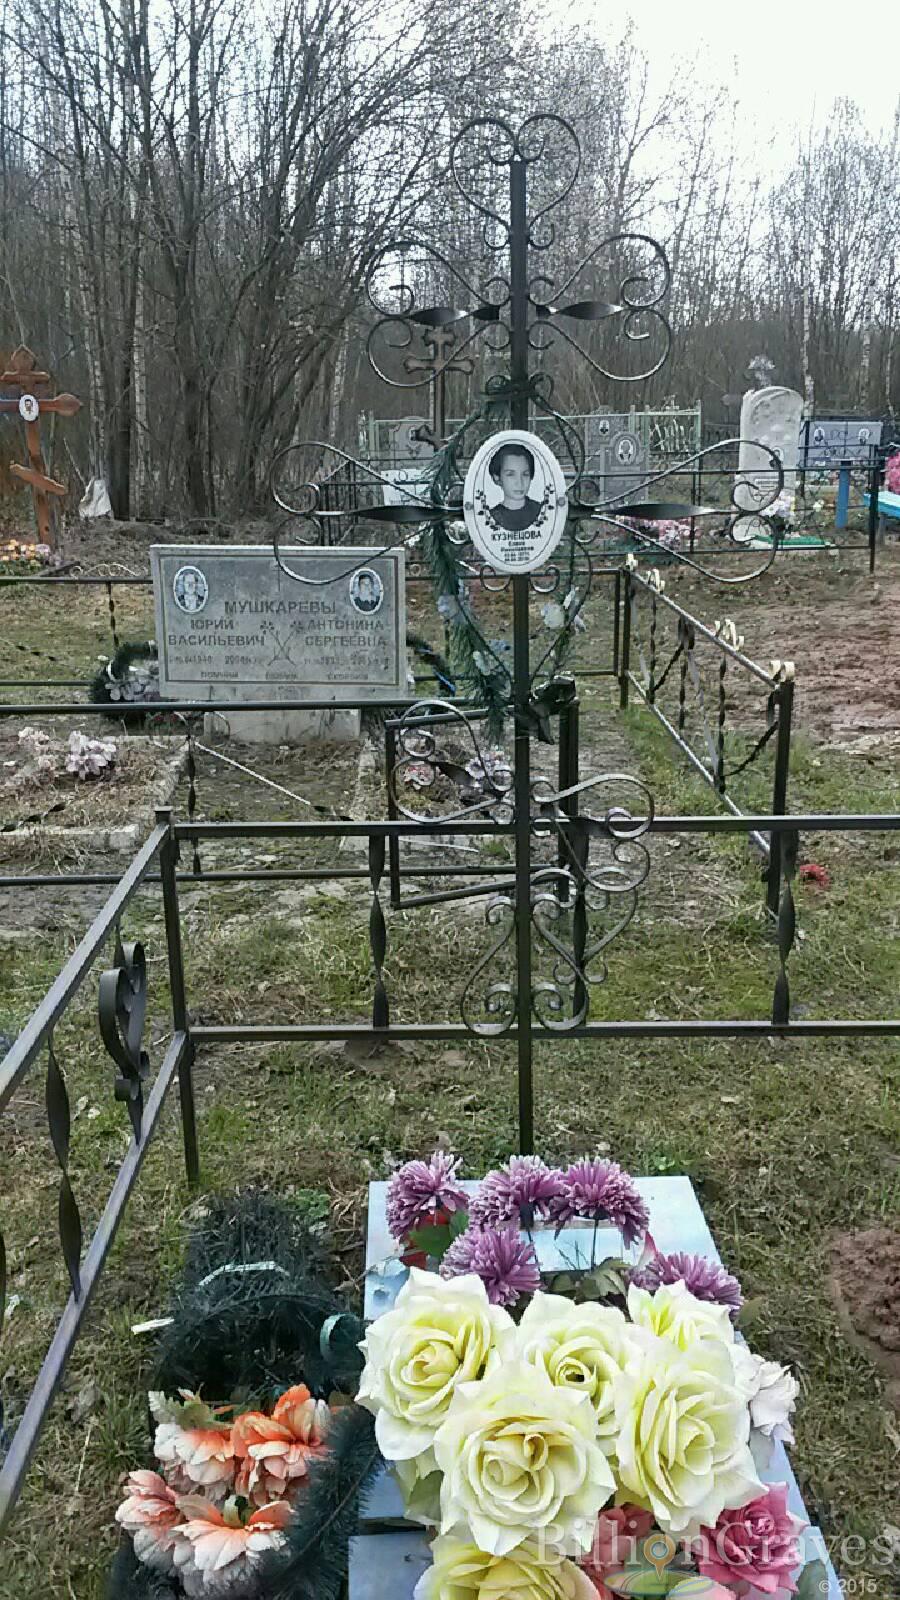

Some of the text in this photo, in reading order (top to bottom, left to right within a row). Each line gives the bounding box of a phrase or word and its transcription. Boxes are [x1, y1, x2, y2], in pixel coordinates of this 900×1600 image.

[491, 530, 542, 541] КУЗНЕЦОВА
[224, 600, 336, 615] МУШКАРЕВЫ
[190, 618, 235, 630] ЮРИЙ
[306, 620, 384, 631] АНТОНИНА
[168, 634, 265, 647] ВАСИЛЬЕВИЧ
[304, 635, 385, 647] СЕРГЕЕВНА
